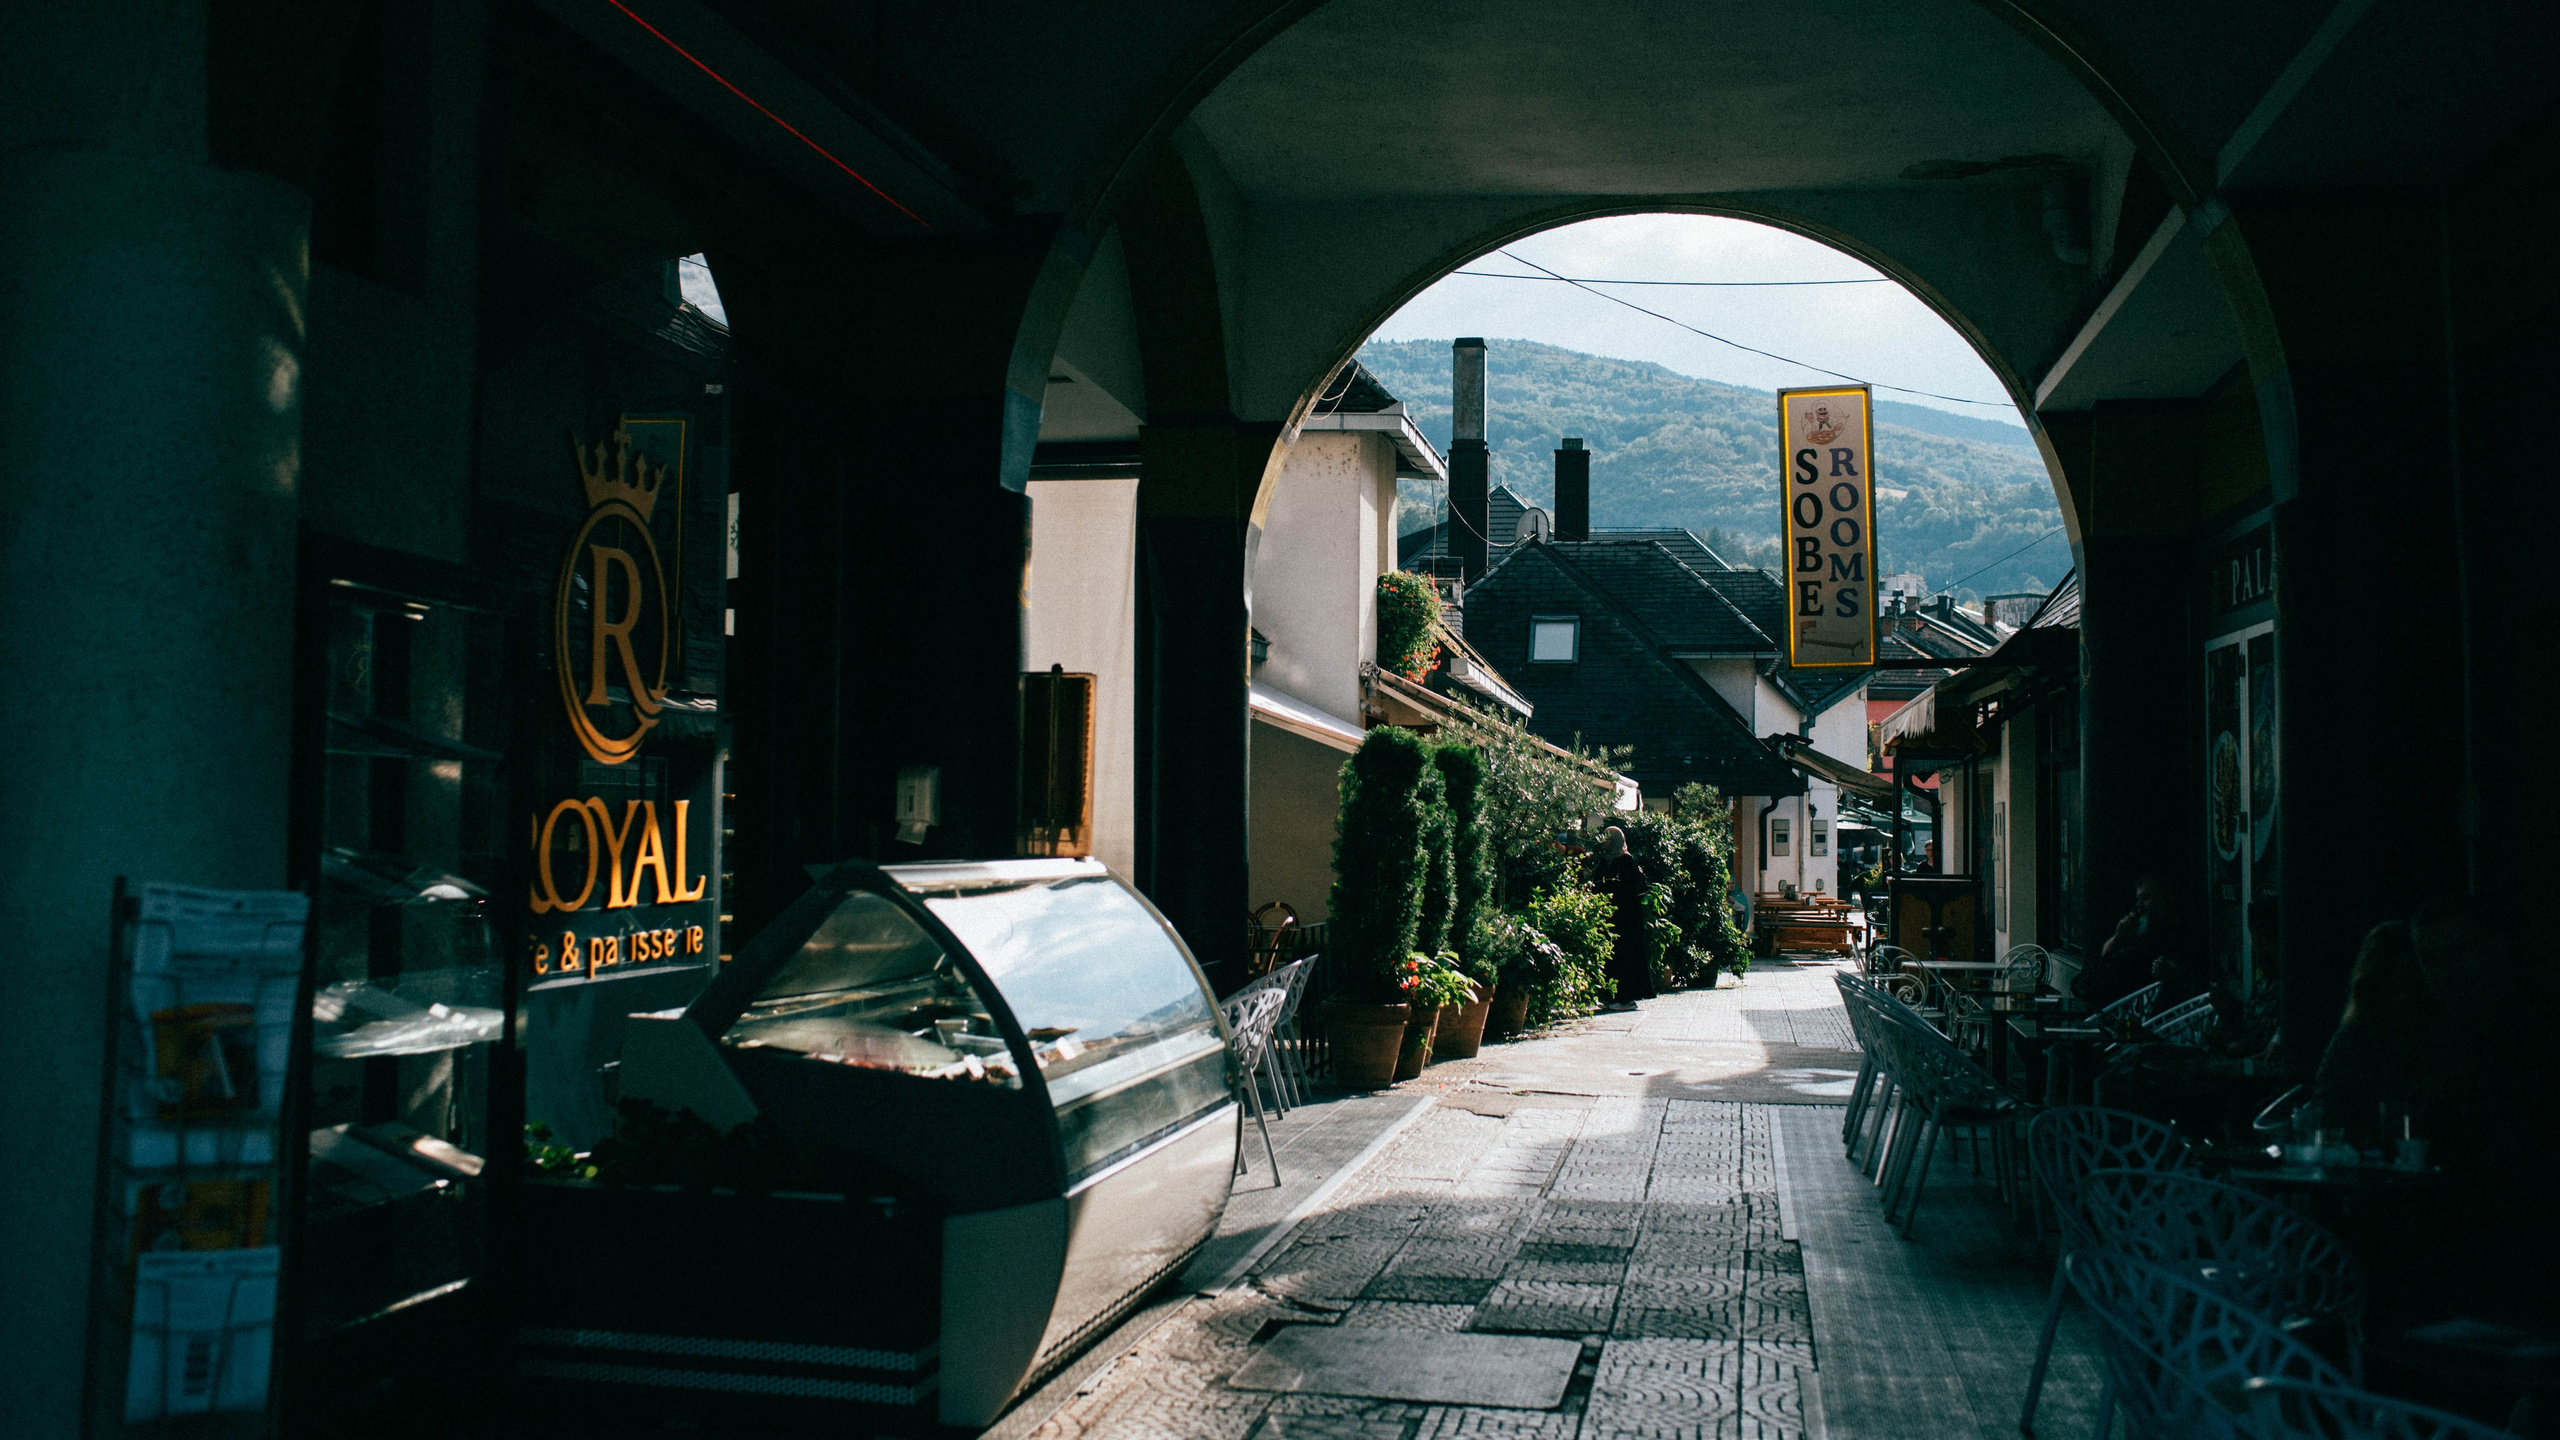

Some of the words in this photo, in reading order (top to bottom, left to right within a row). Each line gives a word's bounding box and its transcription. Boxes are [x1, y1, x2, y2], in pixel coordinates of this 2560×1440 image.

[1793, 448, 1824, 617] SOBE
[1828, 447, 1865, 618] ROOMS
[585, 543, 664, 714] R
[560, 930, 580, 972] &
